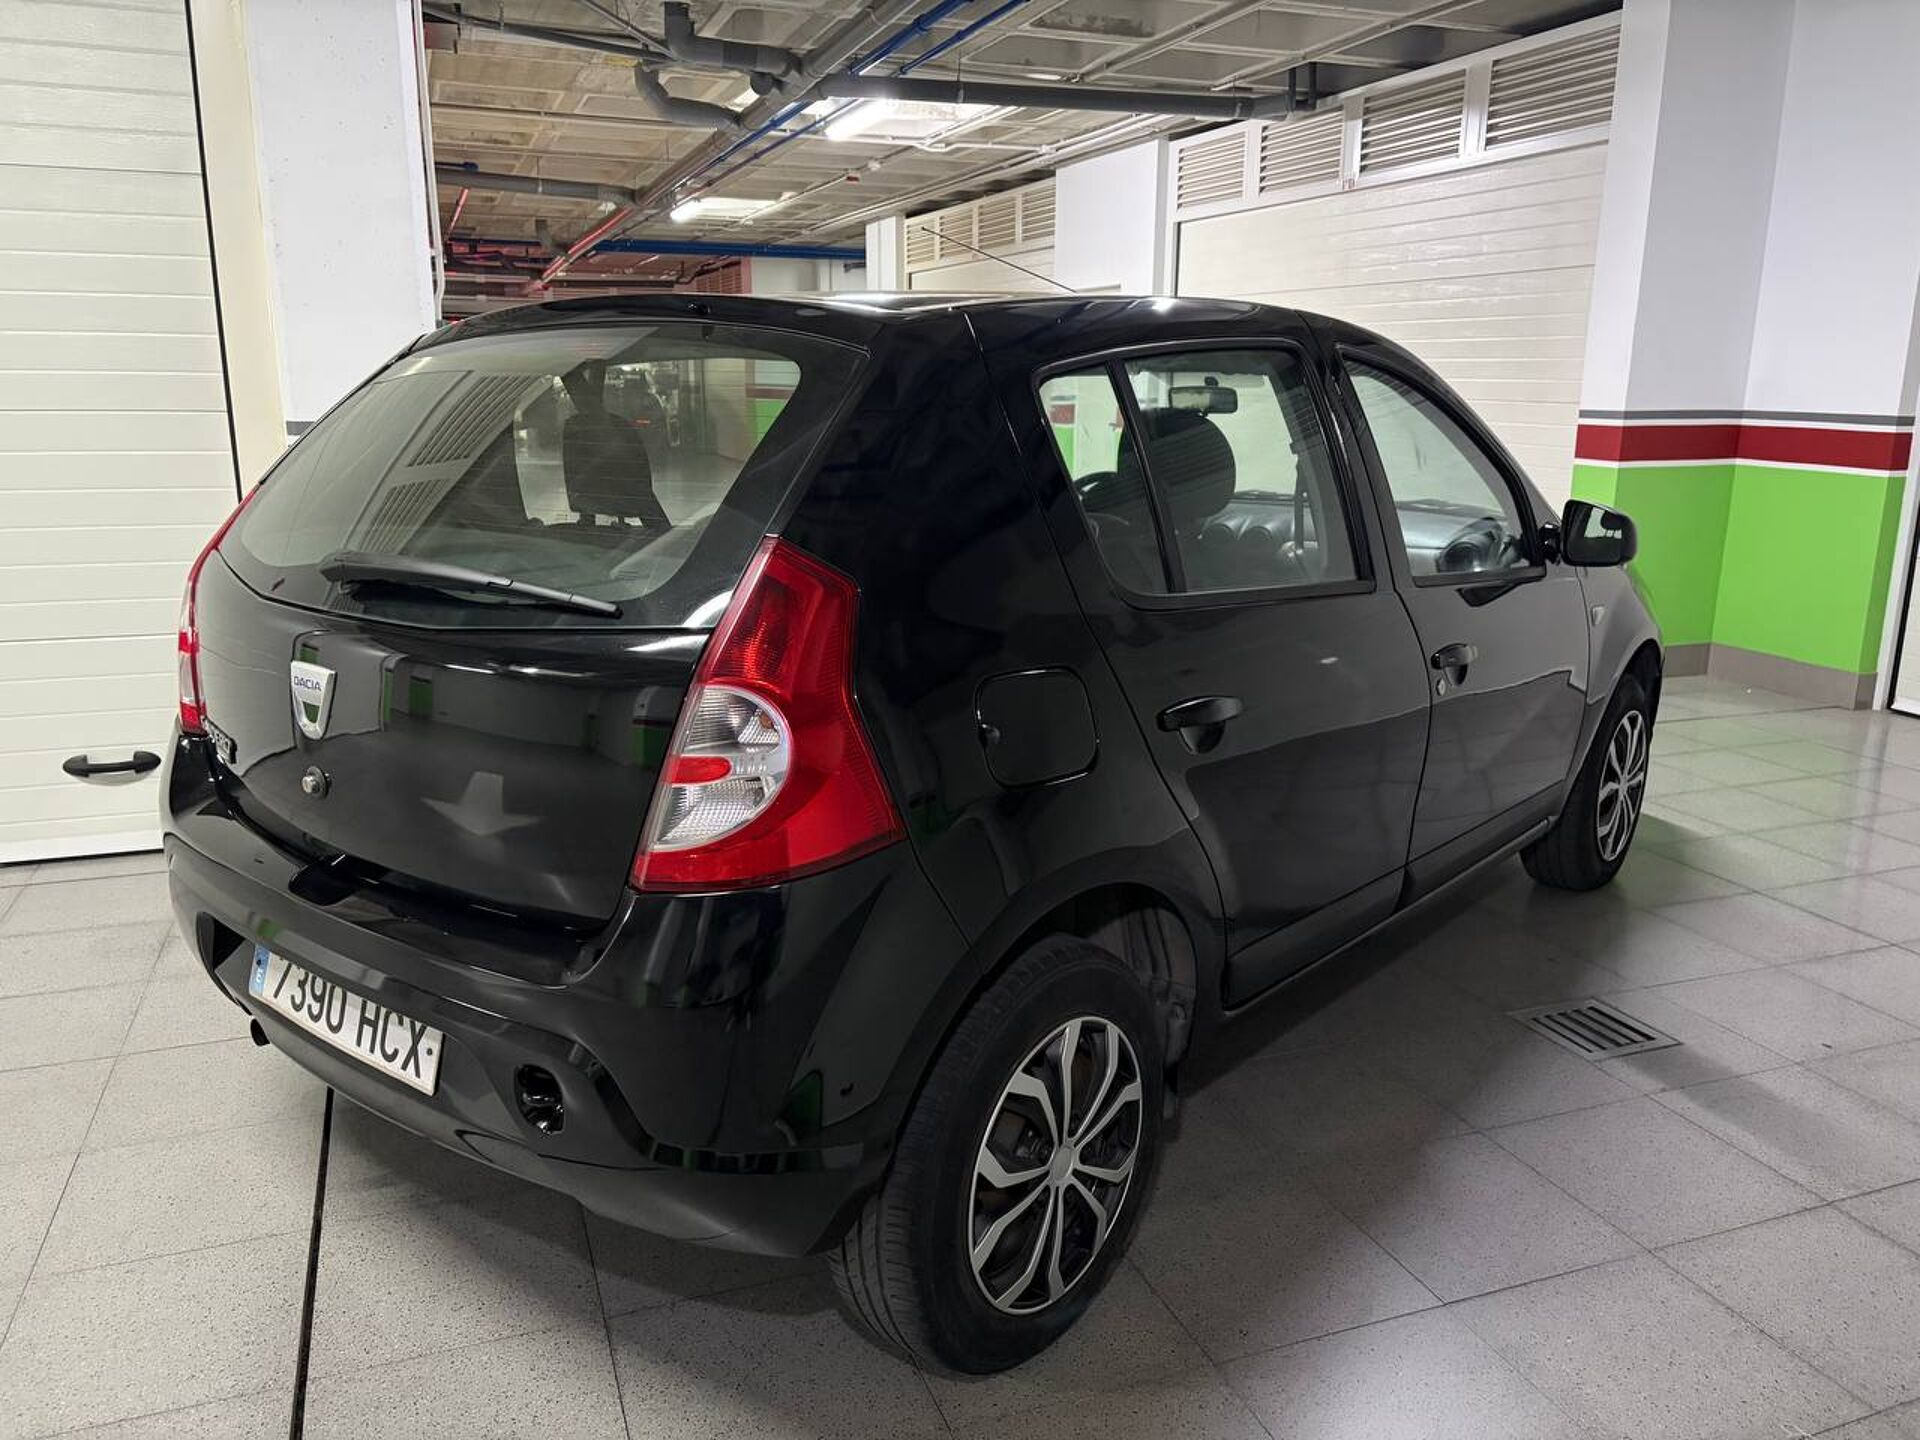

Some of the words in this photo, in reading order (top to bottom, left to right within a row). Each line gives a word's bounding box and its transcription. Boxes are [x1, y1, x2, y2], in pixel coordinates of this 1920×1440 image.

[293, 675, 322, 692] DACIA
[273, 959, 348, 1035] 7390
[356, 999, 427, 1079] HCX
